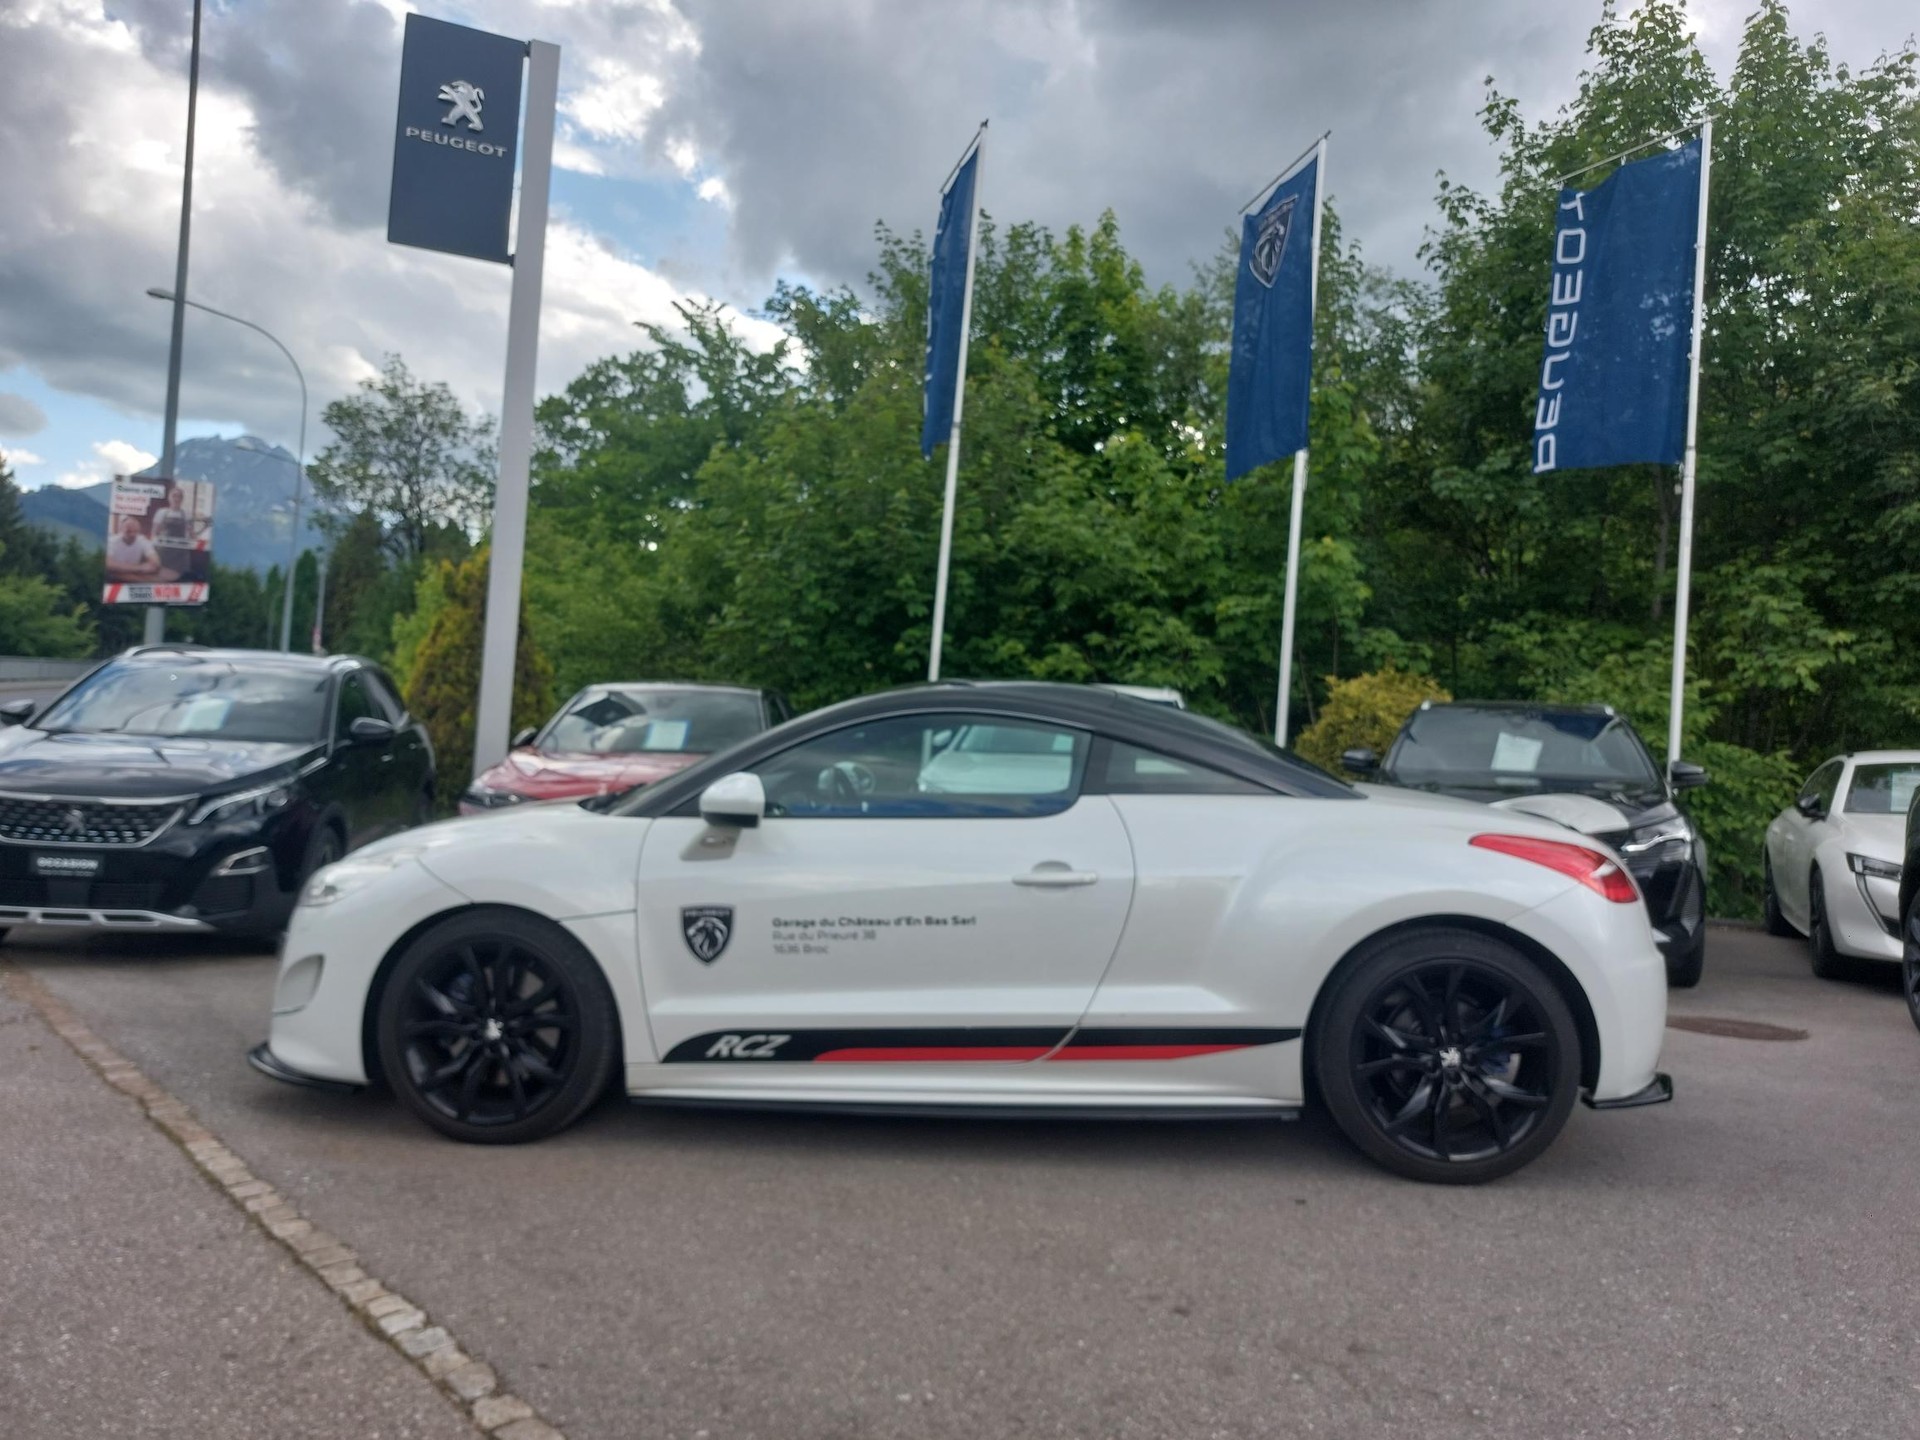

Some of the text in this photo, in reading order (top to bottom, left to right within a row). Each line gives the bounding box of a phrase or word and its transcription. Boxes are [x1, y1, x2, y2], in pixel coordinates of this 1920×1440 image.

[405, 126, 508, 157] PEUGEOT
[772, 917, 816, 929] Garage
[819, 916, 836, 928] du
[838, 916, 891, 927] Château
[894, 915, 922, 926] d'En
[925, 915, 948, 926] Bas
[772, 931, 796, 941] Rue
[798, 931, 814, 941] du
[802, 944, 829, 954] Broc
[705, 1034, 792, 1058] RCZ
